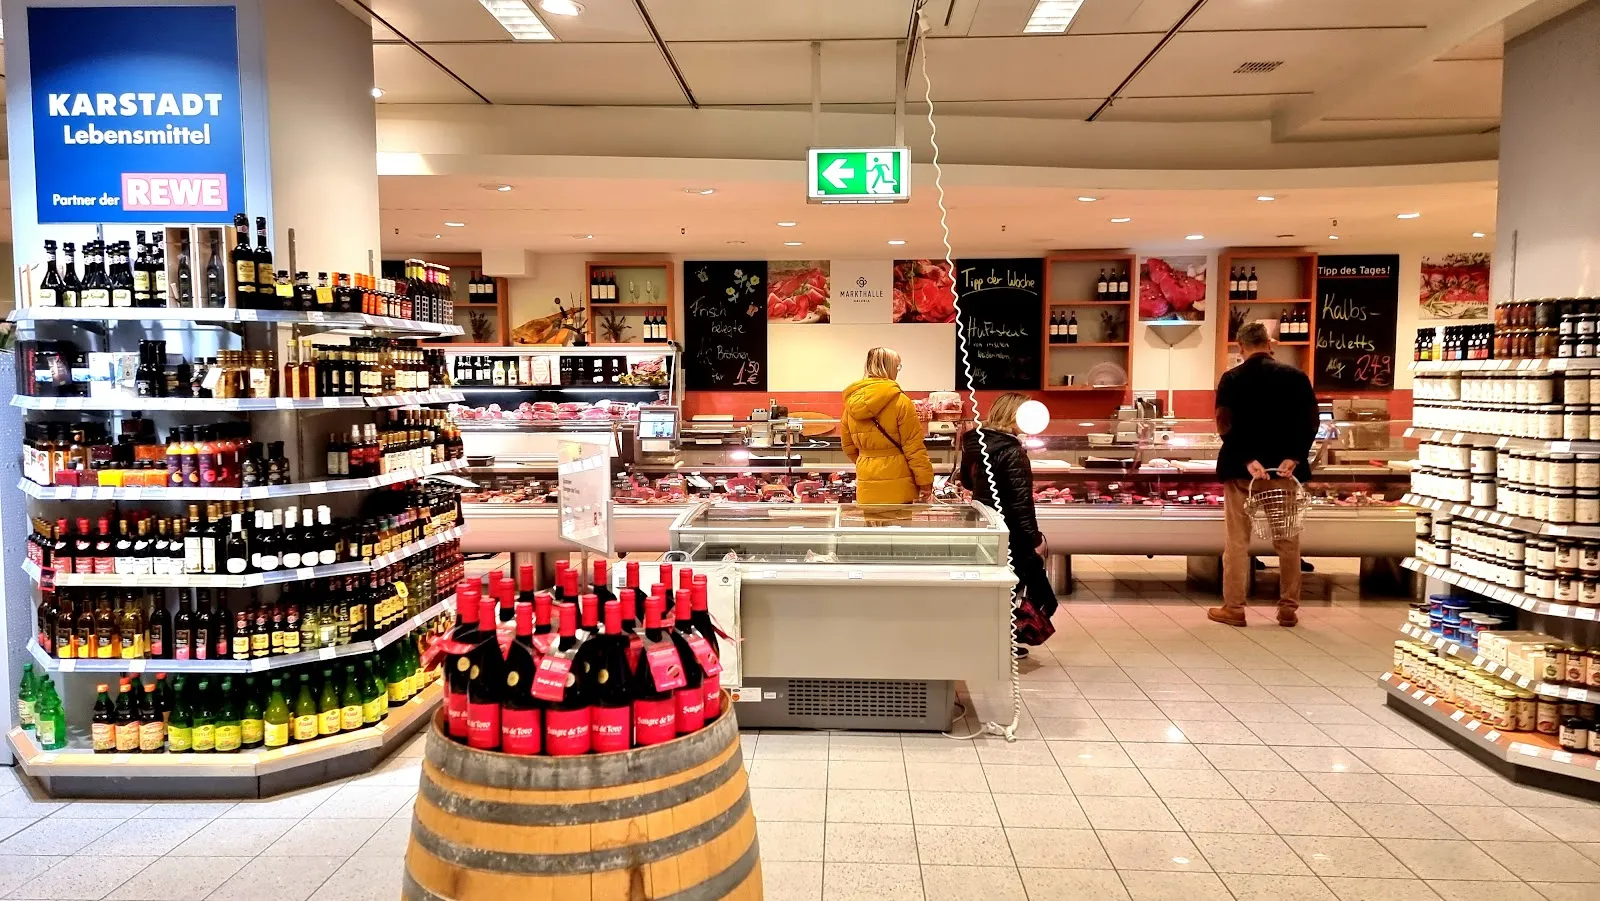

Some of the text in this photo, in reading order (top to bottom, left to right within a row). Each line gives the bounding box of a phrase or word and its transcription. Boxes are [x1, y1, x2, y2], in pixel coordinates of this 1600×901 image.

[49, 93, 222, 116] KARSTADT
[63, 123, 210, 145] Lebensmittel
[52, 178, 223, 206] Partner der REWE
[961, 267, 1035, 290] Tipp der Woche
[1318, 266, 1390, 276] Tipp des Tages!
[690, 295, 727, 317] Frisch
[1322, 293, 1381, 321] Kalbs-
[711, 320, 746, 338] belegte
[747, 373, 760, 385] €
[517, 727, 533, 735] Toro
[607, 725, 623, 733] Toro
